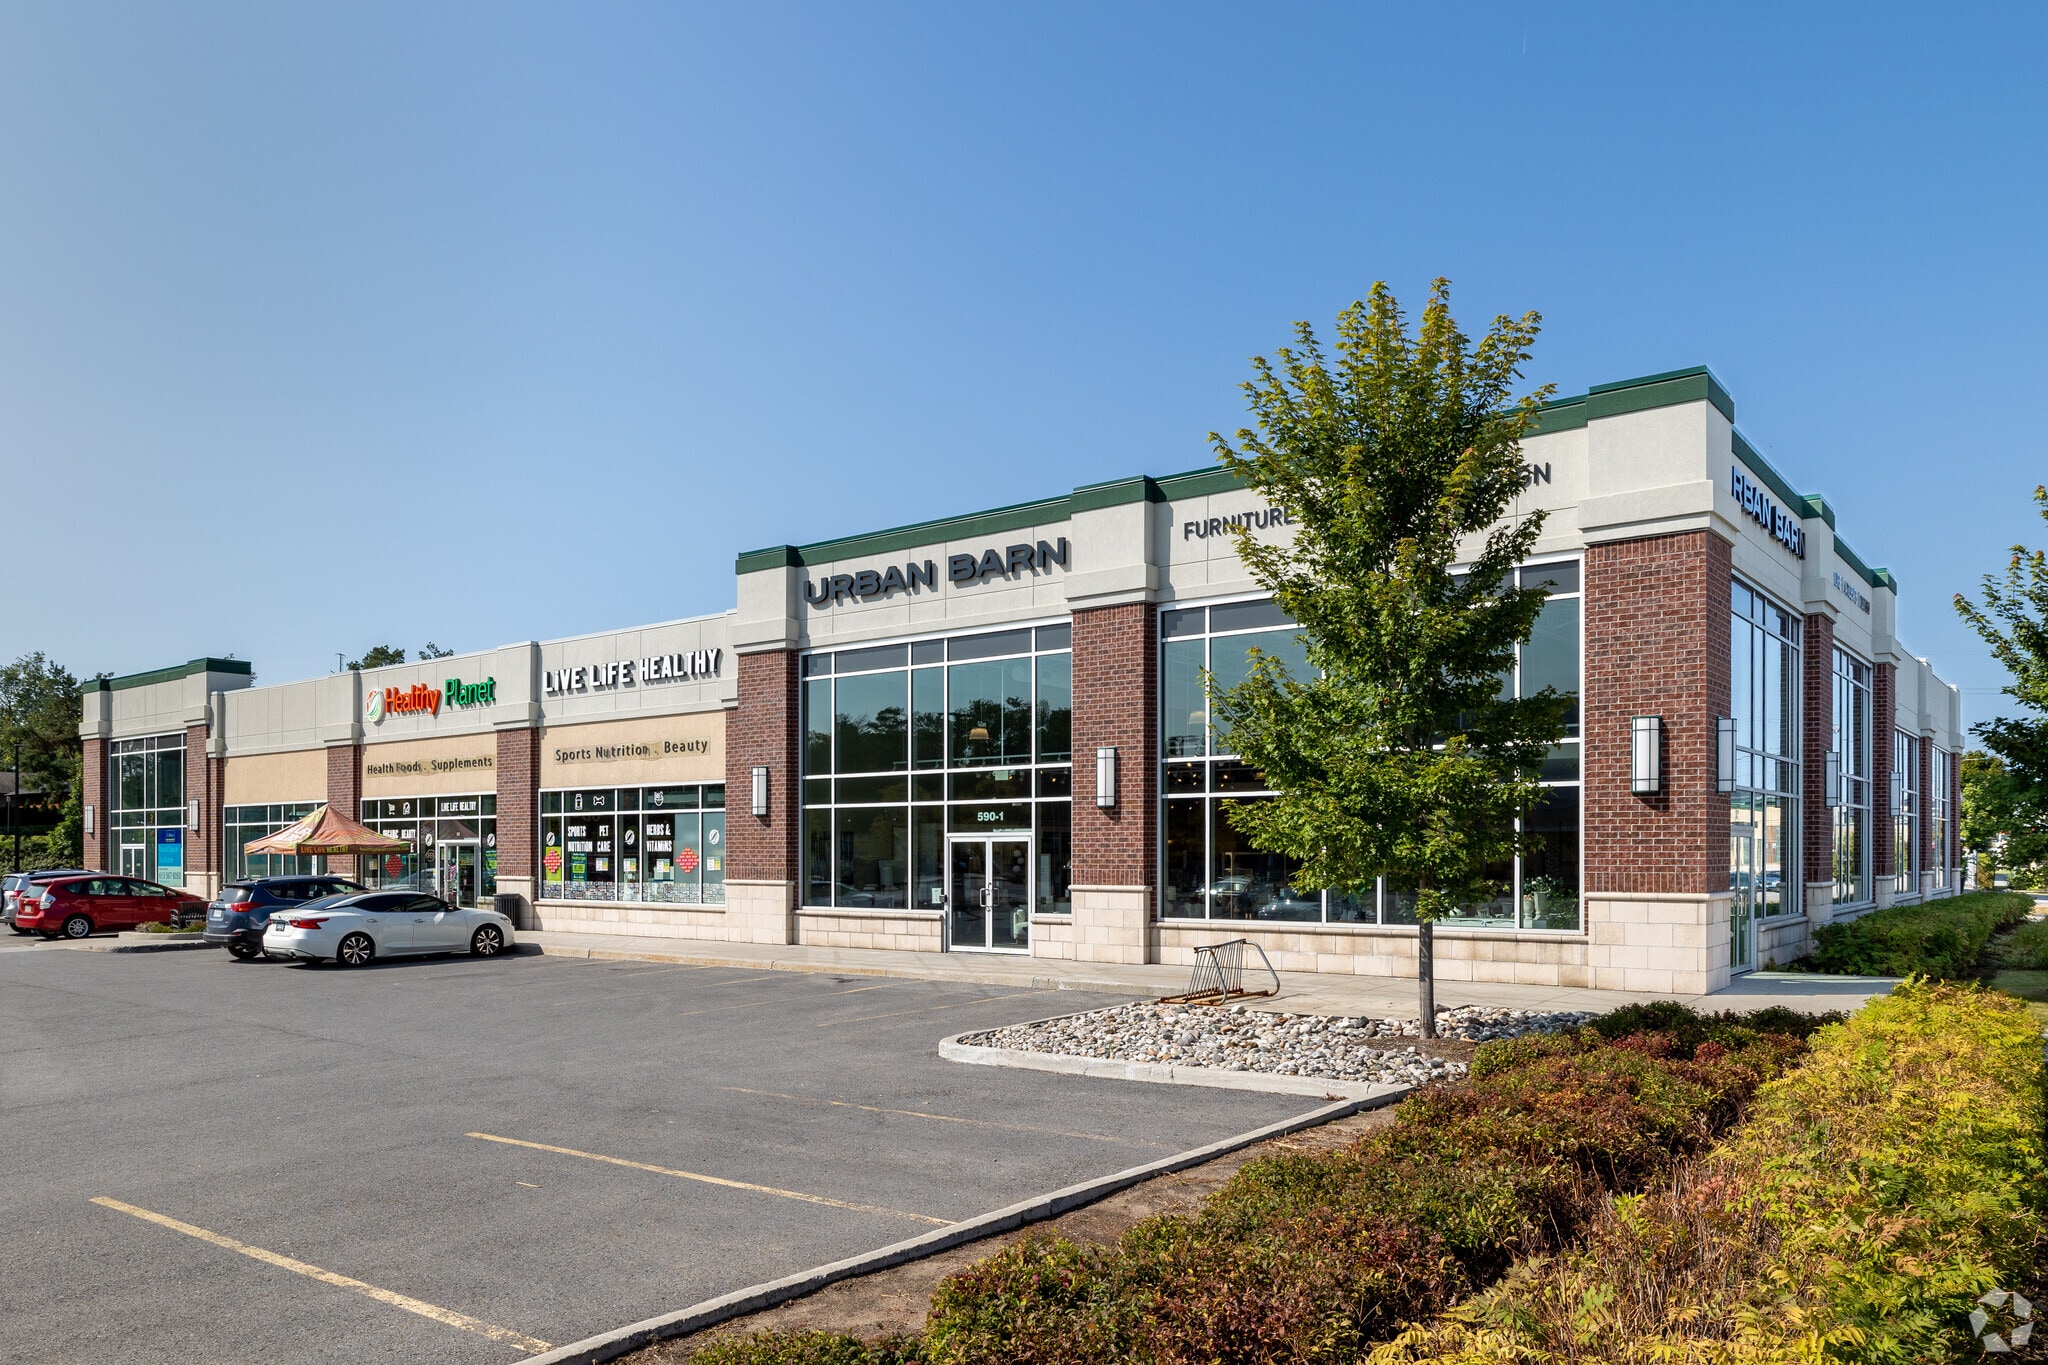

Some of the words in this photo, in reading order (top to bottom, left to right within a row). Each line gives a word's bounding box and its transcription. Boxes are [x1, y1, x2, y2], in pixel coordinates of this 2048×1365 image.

[1732, 465, 1772, 531] RBAN
[1770, 505, 1806, 561] BARN
[803, 559, 934, 605] URBAN
[948, 536, 1067, 582] BARN
[638, 648, 721, 681] HEALTHY
[385, 682, 441, 715] Healthy
[445, 676, 496, 706] Planet
[555, 748, 591, 763] Sports
[596, 744, 648, 759] Nutrition
[664, 739, 708, 753] Beauty
[367, 763, 394, 775] Health
[396, 761, 421, 774] Foods
[431, 757, 493, 771] Supplements
[977, 811, 1004, 822] 590-1
[567, 825, 587, 837] SPORTS
[599, 825, 609, 837] PET
[646, 823, 664, 836] HERBS
[665, 823, 671, 836] &
[300, 846, 313, 854] LIVE
[314, 846, 326, 854] LIFE
[327, 846, 349, 854] HEALTHY
[567, 841, 593, 853] NUTRITION
[596, 841, 611, 853] CARE
